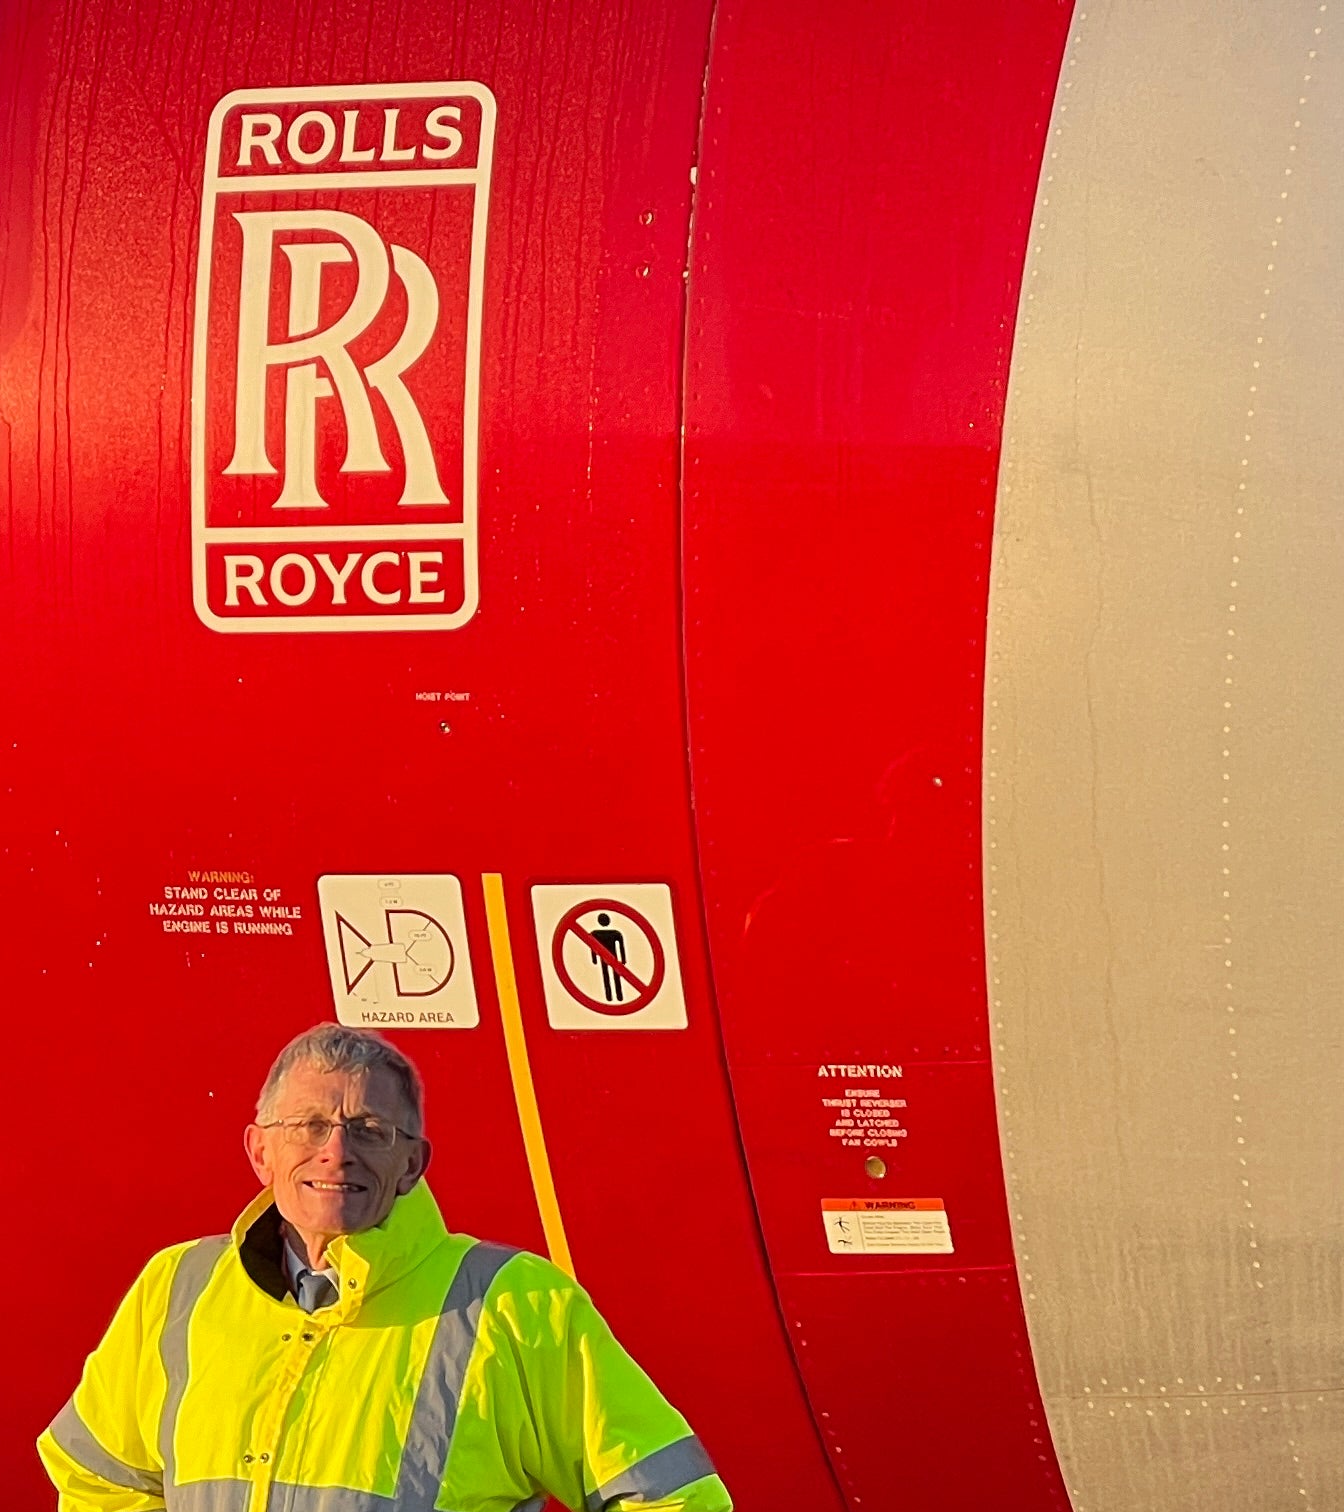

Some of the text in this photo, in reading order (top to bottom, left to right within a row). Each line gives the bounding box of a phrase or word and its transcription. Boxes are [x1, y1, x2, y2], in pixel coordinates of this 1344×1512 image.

[236, 106, 462, 166] ROLLS
[224, 552, 444, 606] ROYCE
[165, 887, 280, 901] STAND CLEAR OF
[150, 904, 301, 918] HAZARD AREAS WHILE
[163, 920, 292, 935] ENGINE IS RUNNING
[362, 1012, 455, 1023] HAZARD AREA
[818, 1065, 902, 1078] ATTENTION
[822, 1099, 856, 1107] THRUST
[857, 1119, 899, 1127] LATCHED
[830, 1129, 864, 1137] BEFORE
[864, 1201, 916, 1209] WARNING
